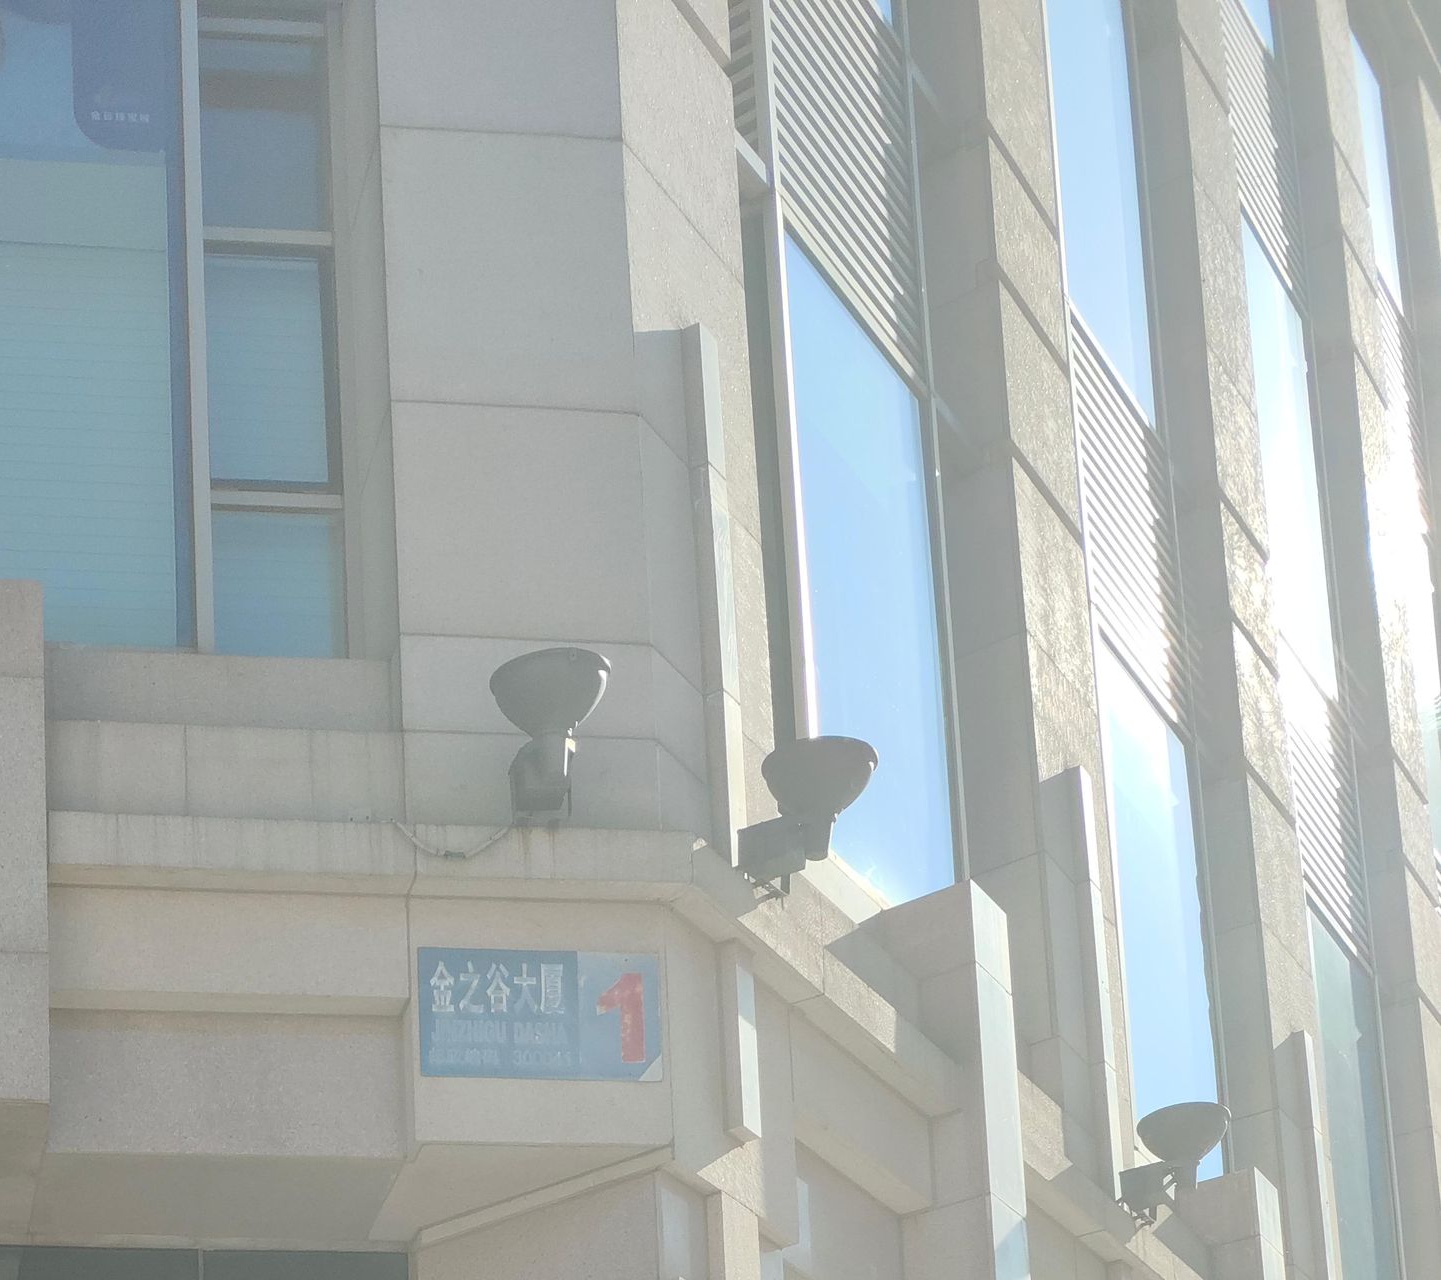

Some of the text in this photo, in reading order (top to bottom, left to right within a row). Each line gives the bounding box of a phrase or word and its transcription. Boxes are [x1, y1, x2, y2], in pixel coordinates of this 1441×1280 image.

[430, 960, 566, 1015] 金之谷大厦
[596, 972, 647, 1064] 1
